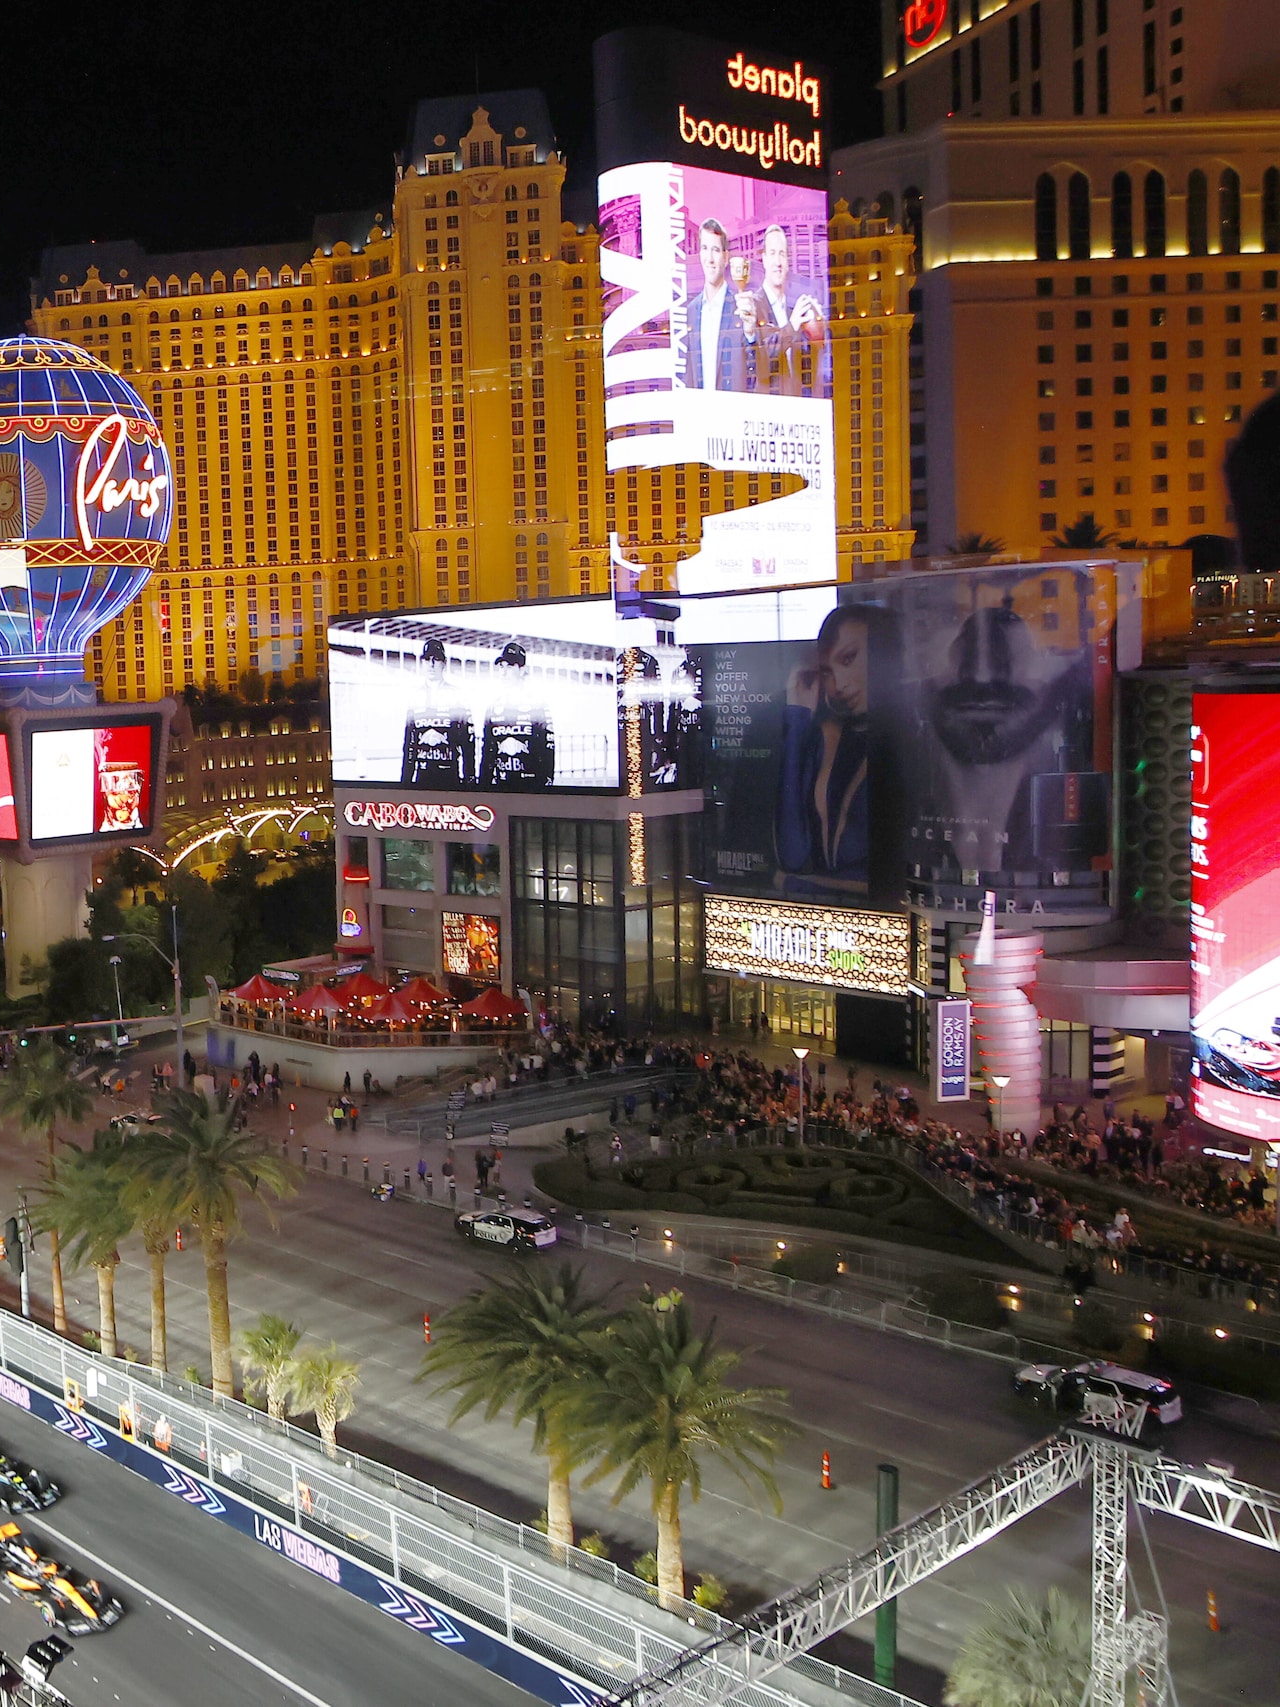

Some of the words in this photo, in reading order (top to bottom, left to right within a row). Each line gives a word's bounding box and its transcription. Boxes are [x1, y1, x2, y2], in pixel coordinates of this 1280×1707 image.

[74, 413, 168, 551] Paris
[715, 650, 736, 659] MAY
[715, 661, 733, 670] WE
[715, 672, 748, 681] OFFER
[715, 683, 737, 692] YOU
[738, 683, 747, 692] A
[715, 694, 740, 703] NEW
[743, 693, 772, 703] LOOK
[715, 705, 729, 714] TO
[731, 705, 747, 714] GO
[414, 718, 451, 728] ORACLE
[715, 716, 752, 725] ALONG
[492, 726, 533, 736] ORACLE
[715, 726, 744, 736] WITH
[716, 737, 743, 747] THAT
[344, 801, 417, 831] CABO
[414, 803, 474, 824] WABO
[421, 822, 468, 831] CANTINA
[911, 827, 1009, 843] OCEAN
[751, 923, 826, 966] MIRACLE
[827, 930, 856, 951] MILE
[828, 948, 865, 973] SHOPS
[943, 1017, 954, 1067] GORDON
[953, 1016, 964, 1067] RAMSAY
[253, 1514, 281, 1551] LAS
[280, 1528, 341, 1584] VEGAS
